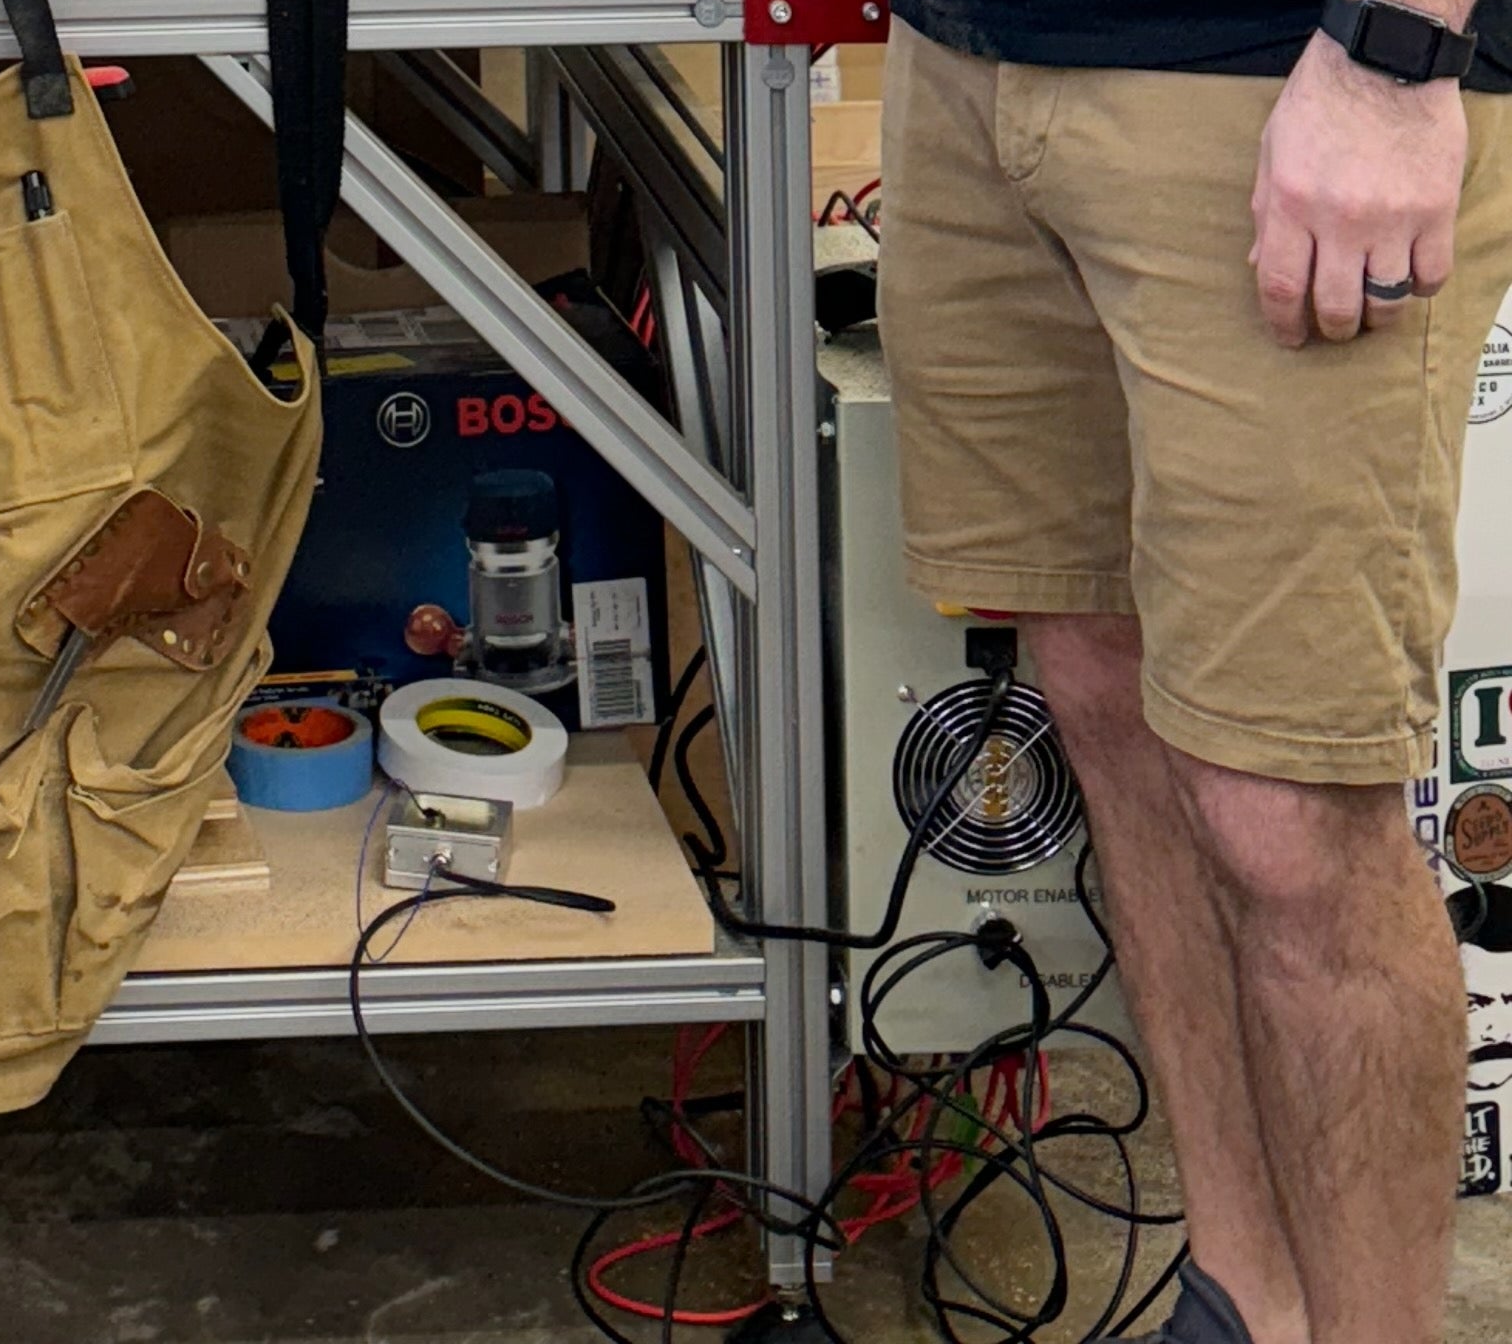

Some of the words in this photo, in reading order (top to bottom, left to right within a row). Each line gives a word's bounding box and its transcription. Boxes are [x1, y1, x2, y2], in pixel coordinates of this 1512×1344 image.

[457, 394, 573, 437] BOS
[967, 889, 1029, 903] MOTOR
[1034, 888, 1104, 903] ENABE
[1019, 973, 1100, 988] DSABLE
